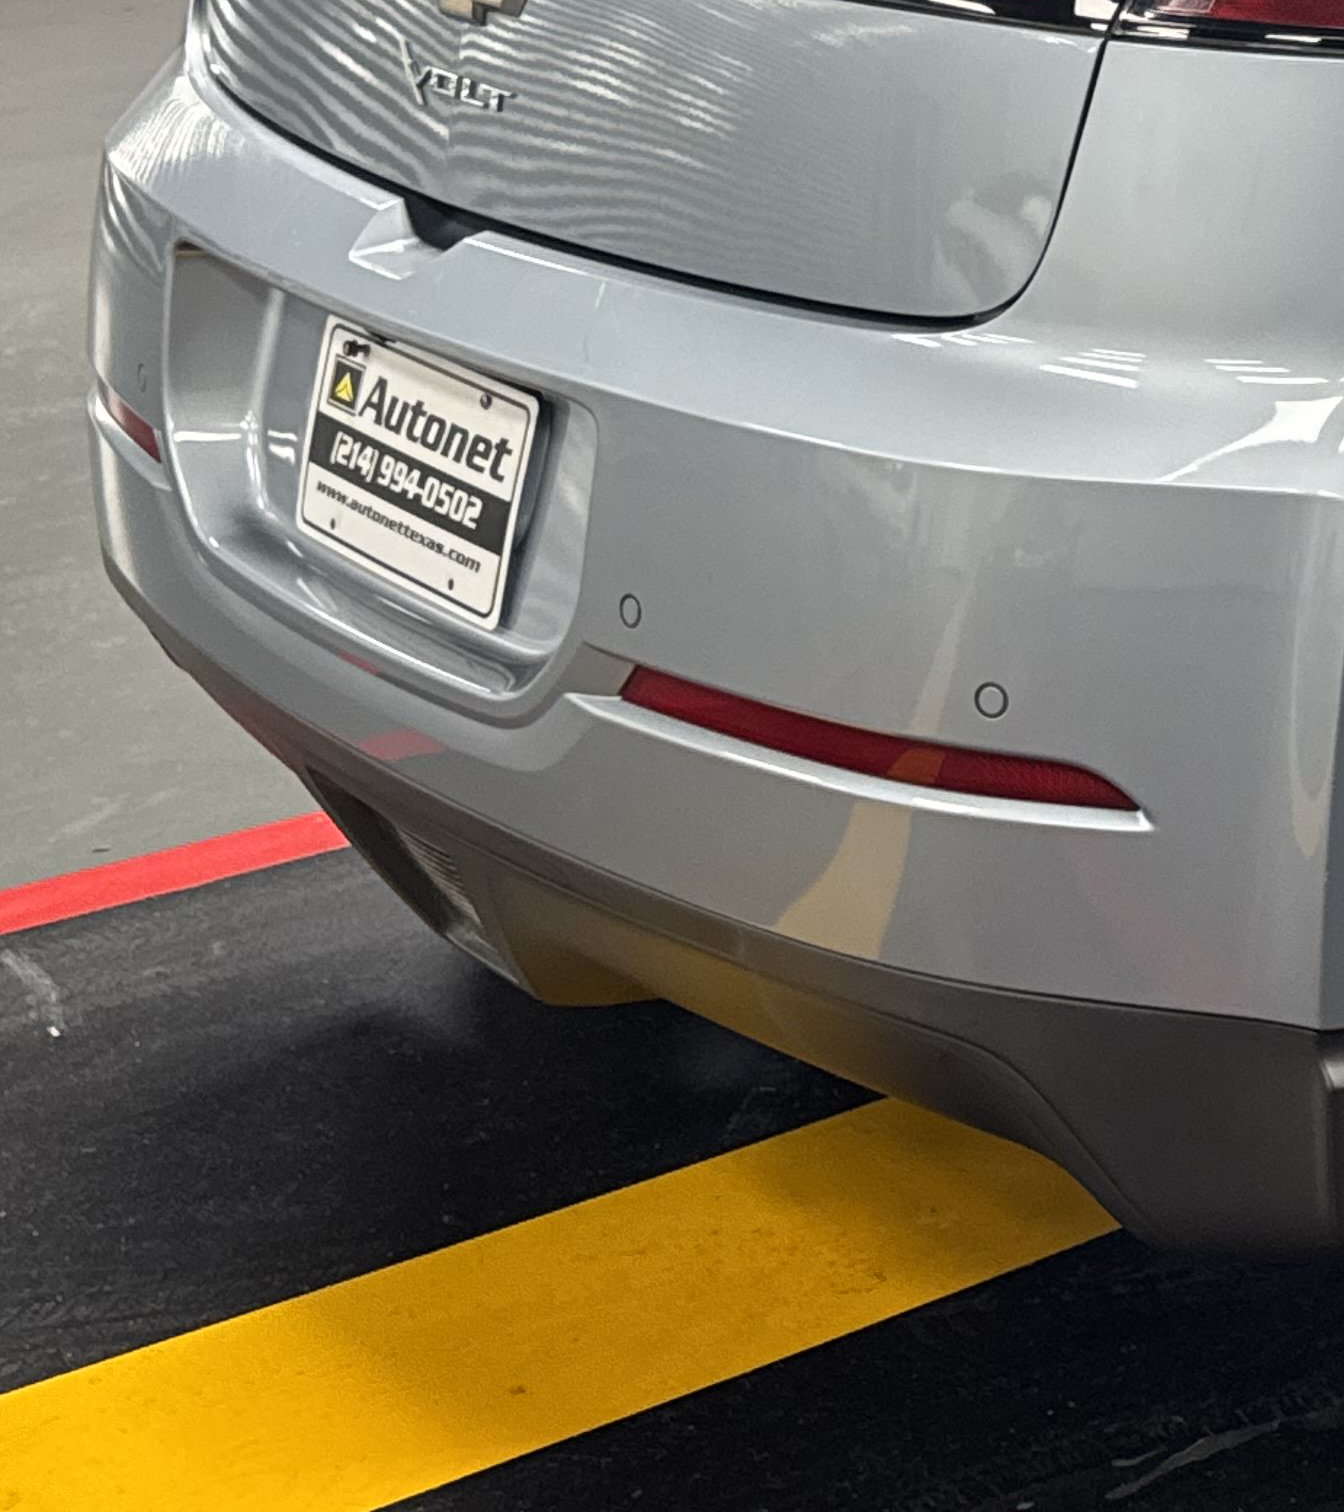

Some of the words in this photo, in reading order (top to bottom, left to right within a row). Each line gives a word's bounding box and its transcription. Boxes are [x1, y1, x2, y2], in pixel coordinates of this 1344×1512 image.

[398, 36, 517, 112] VOLT
[358, 376, 513, 483] Autonet
[316, 480, 482, 573] www.autonettexas.com
[329, 431, 380, 483] (214)
[377, 455, 483, 530] 994-0502
